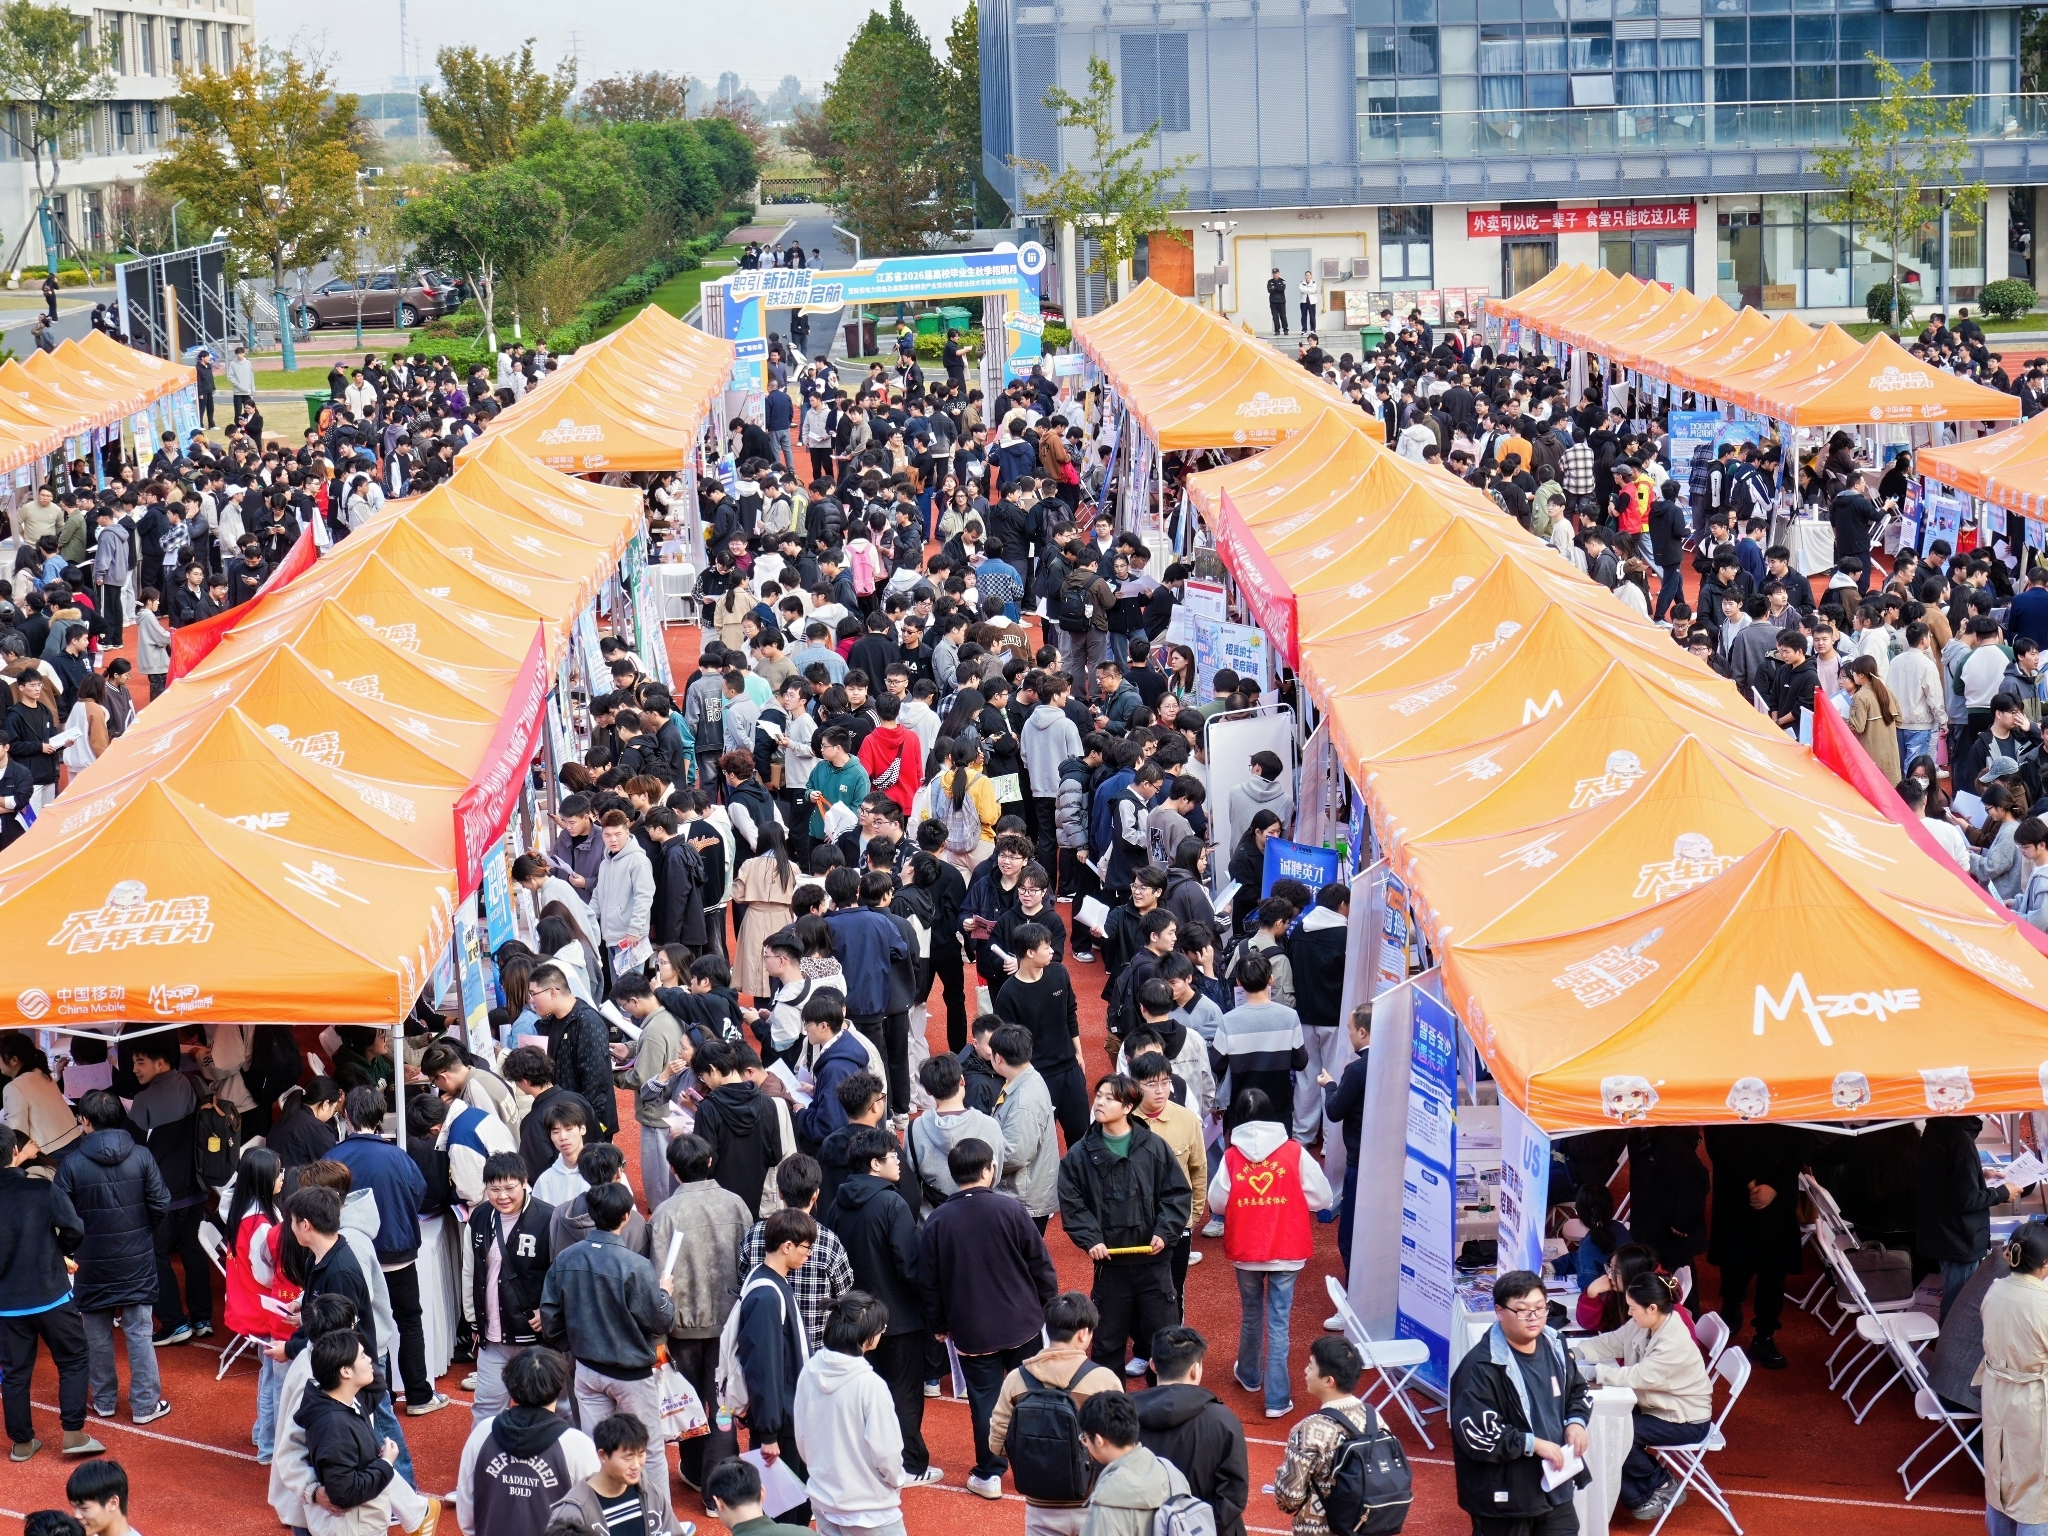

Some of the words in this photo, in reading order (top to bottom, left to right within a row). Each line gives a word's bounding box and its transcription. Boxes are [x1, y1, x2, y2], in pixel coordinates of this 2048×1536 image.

[1474, 212, 1579, 232] 外卖可以吃一辈子
[1586, 207, 1691, 227] 食堂只能吃这几年
[732, 270, 812, 291] 职引新动能
[876, 264, 1018, 283] 江苏省2026届高校毕业生秋季招聘月
[766, 284, 842, 306] 联动助启航
[537, 425, 601, 442] 天生动感
[1225, 643, 1253, 659] 招贤纳士
[1280, 858, 1324, 884] 诚聘英才
[48, 896, 210, 945] 天生动感
[66, 921, 214, 954] 青年有为
[57, 985, 125, 1001] 中国移动
[58, 1001, 88, 1015] China
[91, 1000, 126, 1014] Mobile
[1523, 1135, 1541, 1178] US
[1236, 1196, 1288, 1207] 青年志愿者协会
[516, 1233, 537, 1258] R
[502, 1475, 539, 1487] RADIANT
[509, 1486, 532, 1497] BOLD
